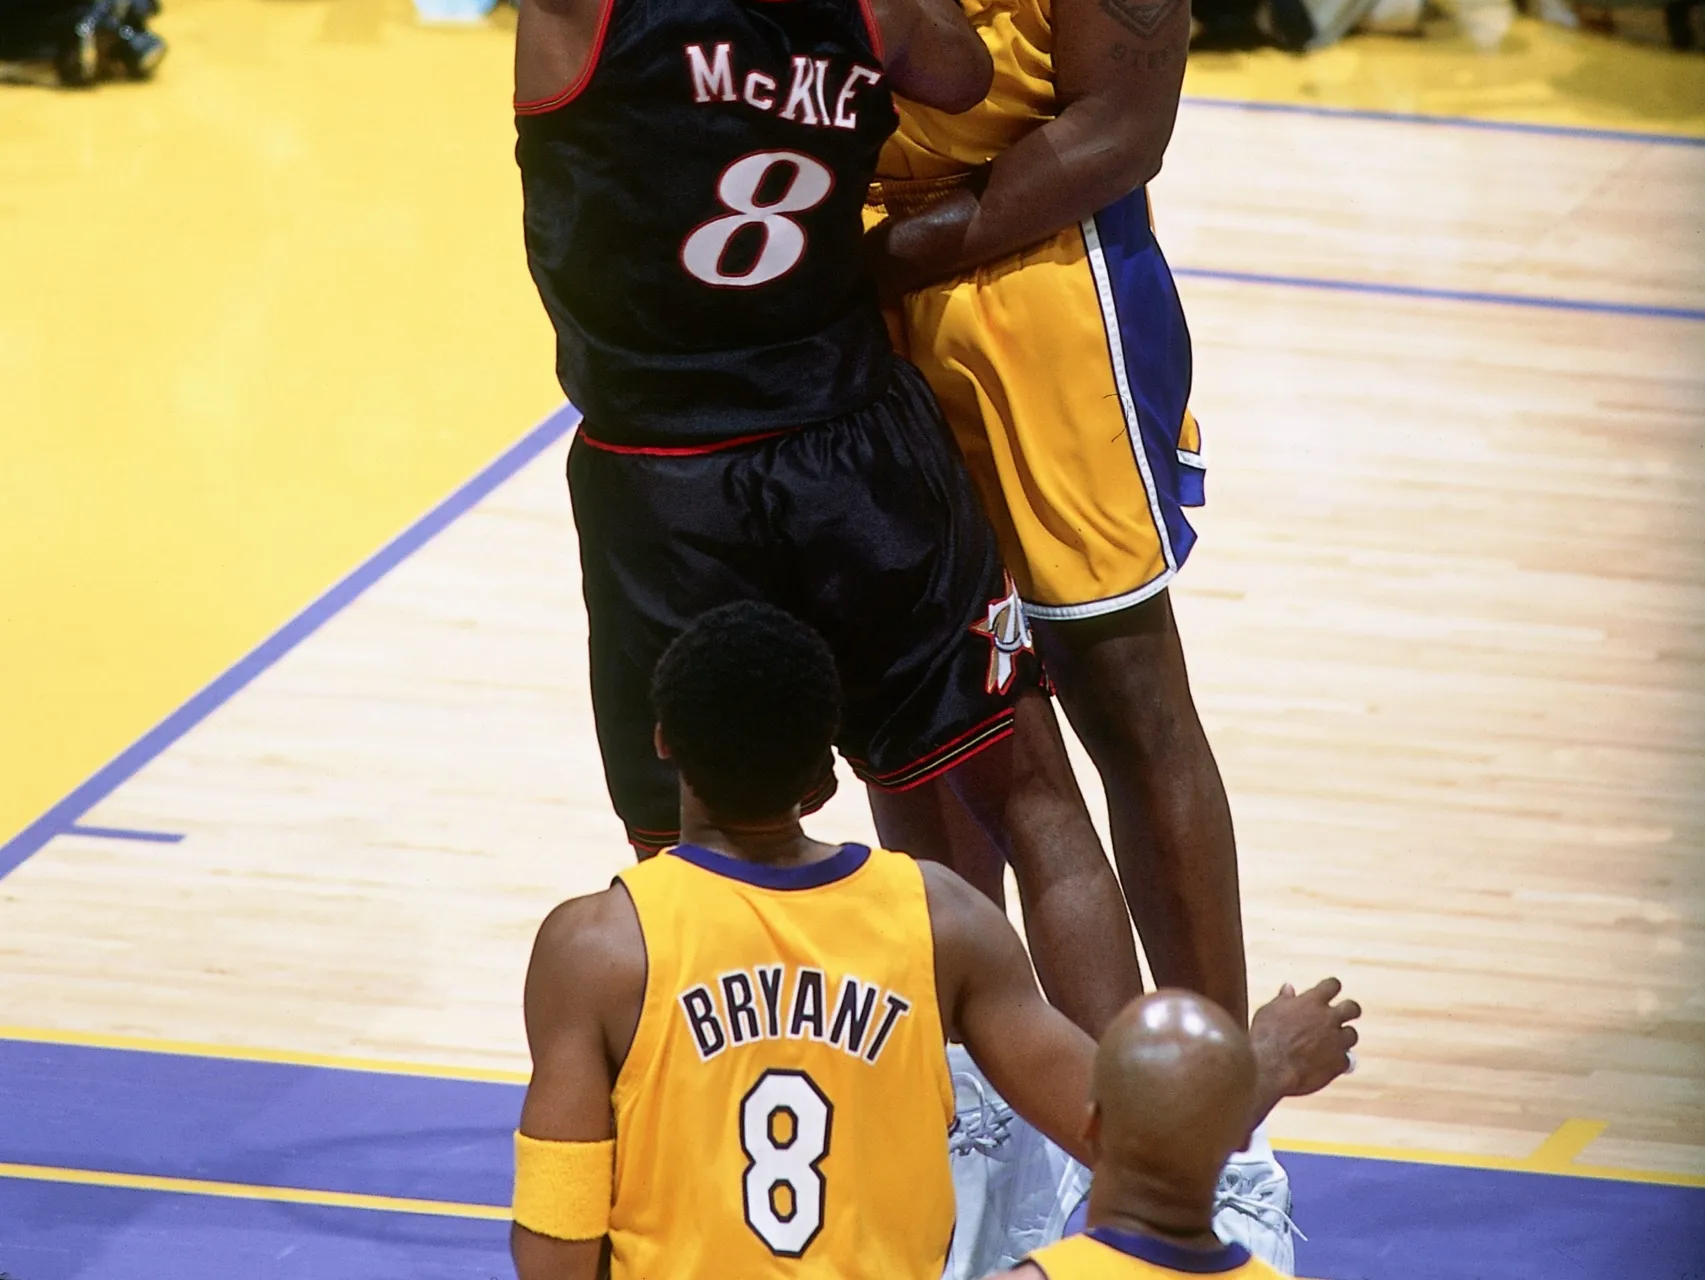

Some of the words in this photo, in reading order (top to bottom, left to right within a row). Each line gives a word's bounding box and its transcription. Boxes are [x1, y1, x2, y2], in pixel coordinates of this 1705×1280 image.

[678, 148, 836, 290] 8
[678, 963, 912, 1065] BRYANT
[739, 1067, 834, 1260] 8
